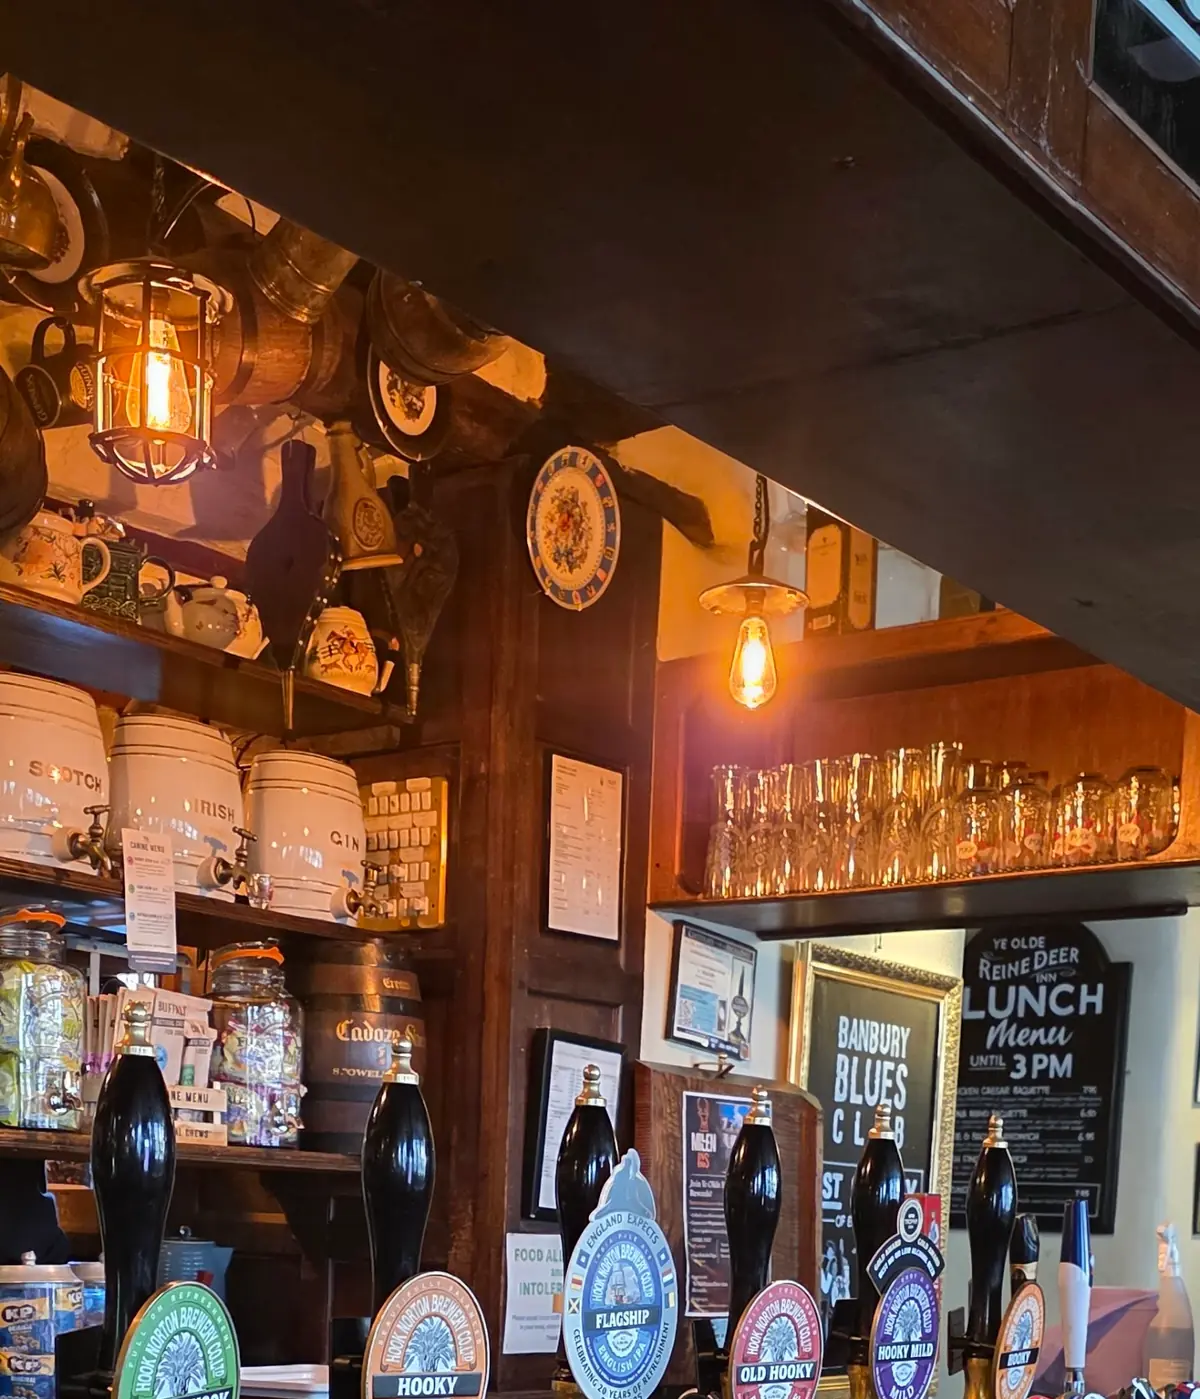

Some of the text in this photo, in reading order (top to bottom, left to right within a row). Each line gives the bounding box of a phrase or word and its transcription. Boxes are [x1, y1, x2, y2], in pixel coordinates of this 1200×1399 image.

[28, 760, 102, 793] SCOTCH
[193, 798, 235, 825] IRISH
[329, 830, 361, 851] GIN
[993, 936, 1046, 950] YE OLDE
[978, 947, 1080, 981] REINE DEER
[1035, 972, 1058, 983] INN
[962, 983, 1105, 1020] LUNCH
[838, 1015, 911, 1059] BANBURY
[986, 1018, 1074, 1050] Menu
[969, 1054, 1006, 1068] UNTIL
[834, 1053, 908, 1111] BLUES
[185, 1092, 209, 1104] MENU
[832, 1108, 905, 1150] CLB
[586, 1213, 623, 1249] ENGLAND
[627, 1213, 660, 1245] EXPECTS
[514, 1248, 544, 1262] FOOD
[592, 1275, 603, 1302] HOOK
[5, 1307, 35, 1320] KP
[180, 1306, 219, 1346] BREWERY
[386, 1334, 407, 1363] HOOK
[397, 1295, 430, 1336] NORTON
[431, 1294, 469, 1332] BREWERY
[596, 1309, 650, 1329] FLAGSHIP
[746, 1329, 762, 1355] HOOK
[755, 1299, 780, 1332] NORTON
[781, 1298, 808, 1329] BREWERY
[883, 1311, 897, 1336] HOOK
[145, 1309, 180, 1357] NORTON
[573, 1328, 599, 1387] CELEBRATING
[597, 1382, 607, 1395] 20
[609, 1389, 632, 1399] YEARS
[632, 1384, 642, 1394] OF
[641, 1321, 670, 1386] REFRESHMENT
[598, 1342, 647, 1373] ENGLISH IPA
[878, 1343, 934, 1361] HOOKY MILD
[136, 1356, 156, 1392] HOOK
[397, 1376, 458, 1396] HOOKY
[740, 1362, 814, 1383] OLD HOOKY
